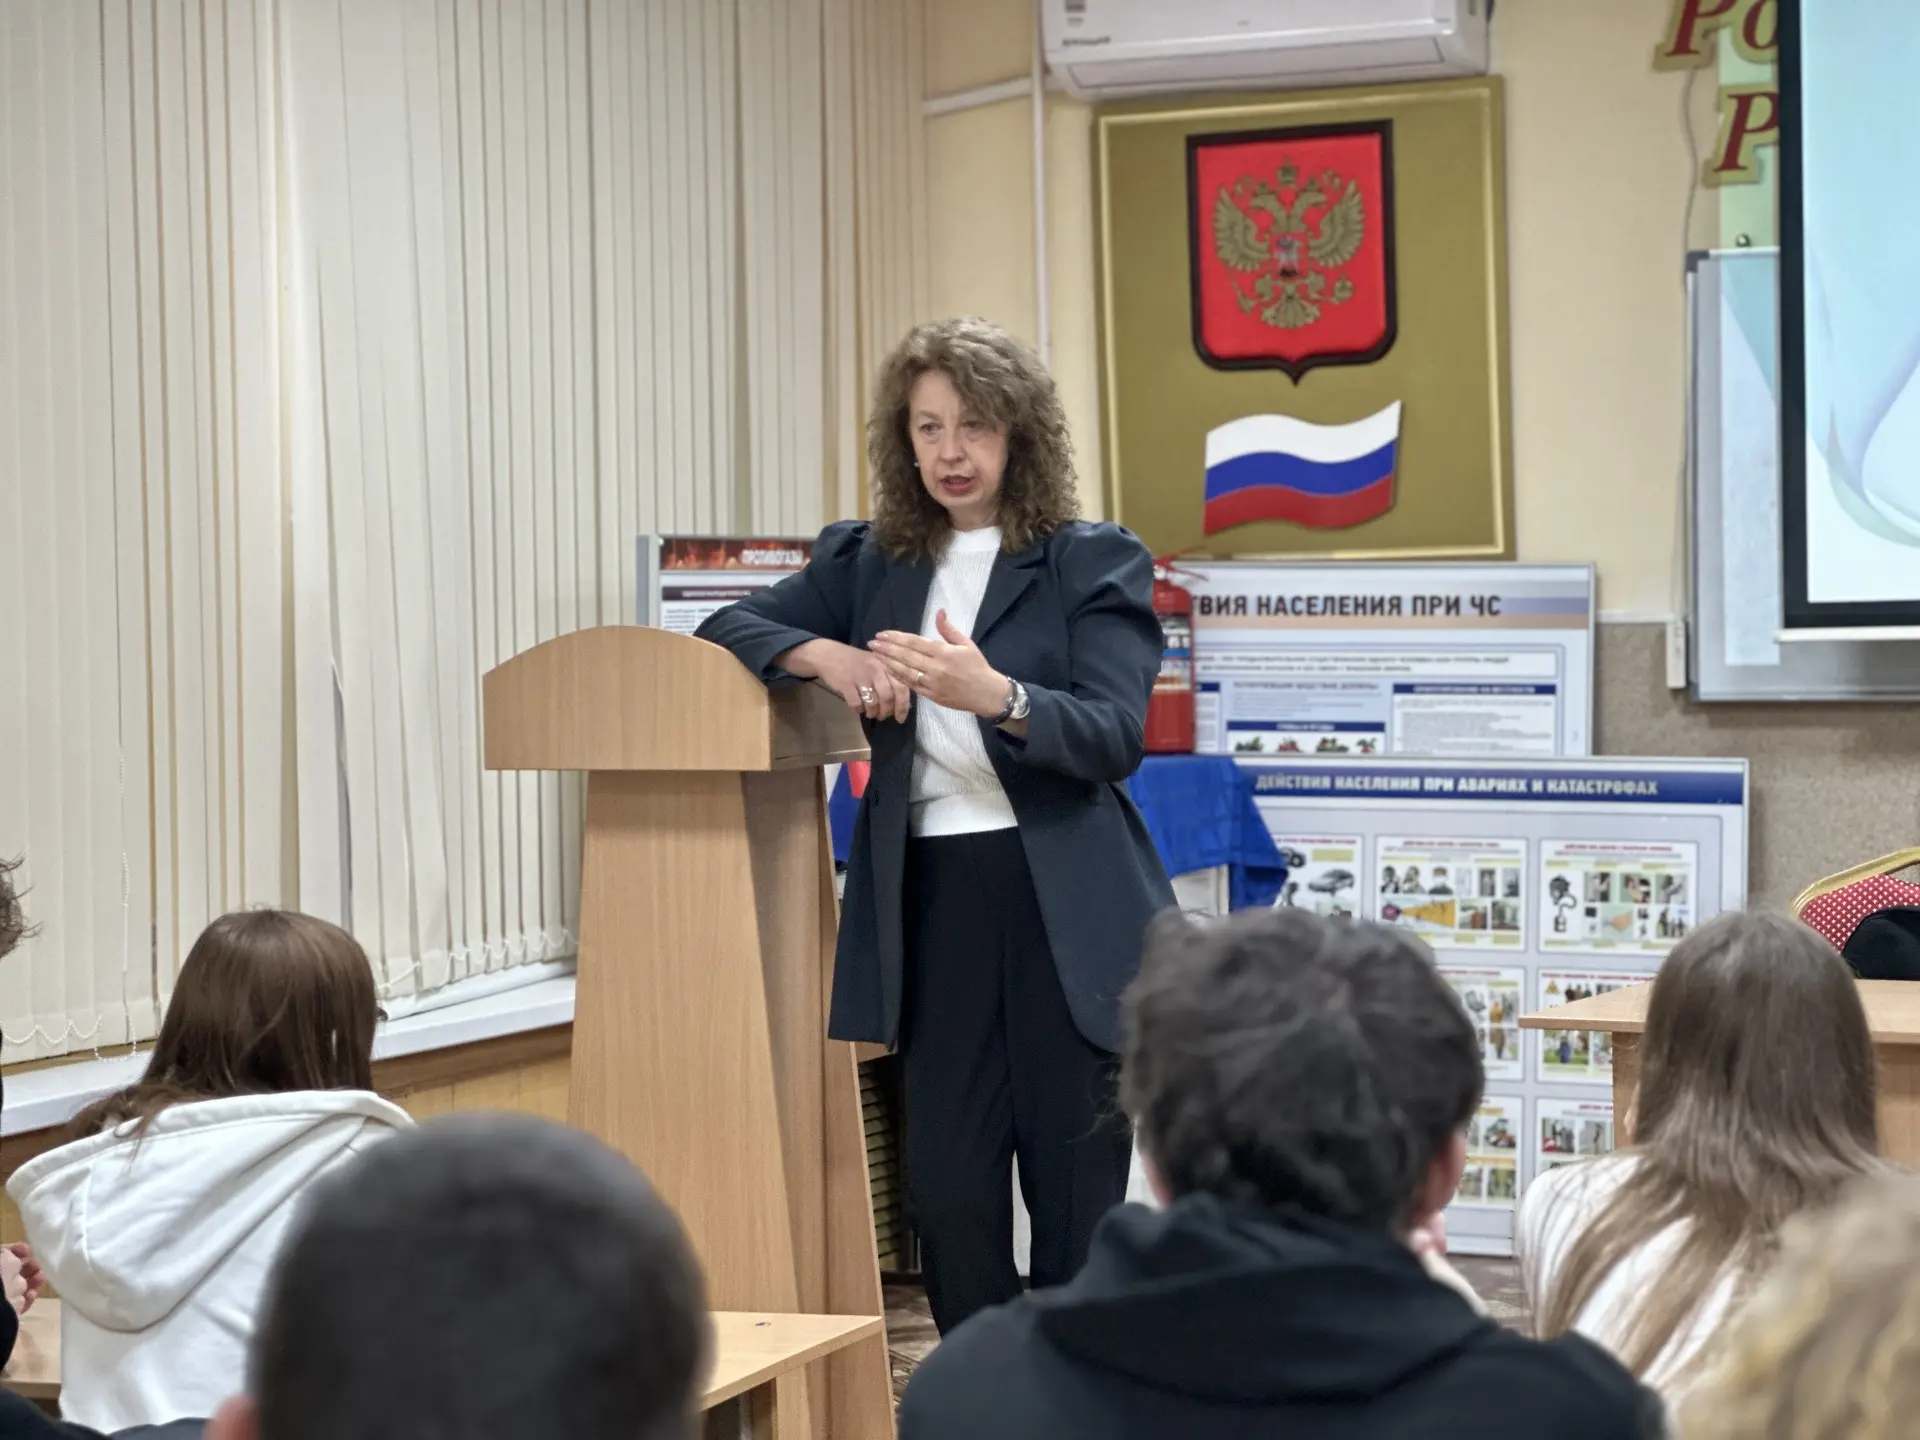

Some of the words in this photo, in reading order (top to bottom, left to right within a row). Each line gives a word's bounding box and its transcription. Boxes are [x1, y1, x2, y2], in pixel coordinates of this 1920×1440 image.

[1256, 594, 1400, 617] НАСЕЛЕНИЯ
[1411, 594, 1461, 616] ПРИ
[1470, 593, 1502, 616] ЧС
[1256, 773, 1332, 791] ДЕЙСТВИЯ
[1334, 775, 1421, 791] НАСЕЛЕНИЯ
[1423, 776, 1454, 792] ПРИ
[1457, 777, 1529, 793] АВАРИЯХ
[1531, 778, 1544, 793] И
[1546, 779, 1659, 796] КАТАСТРОФАХ
